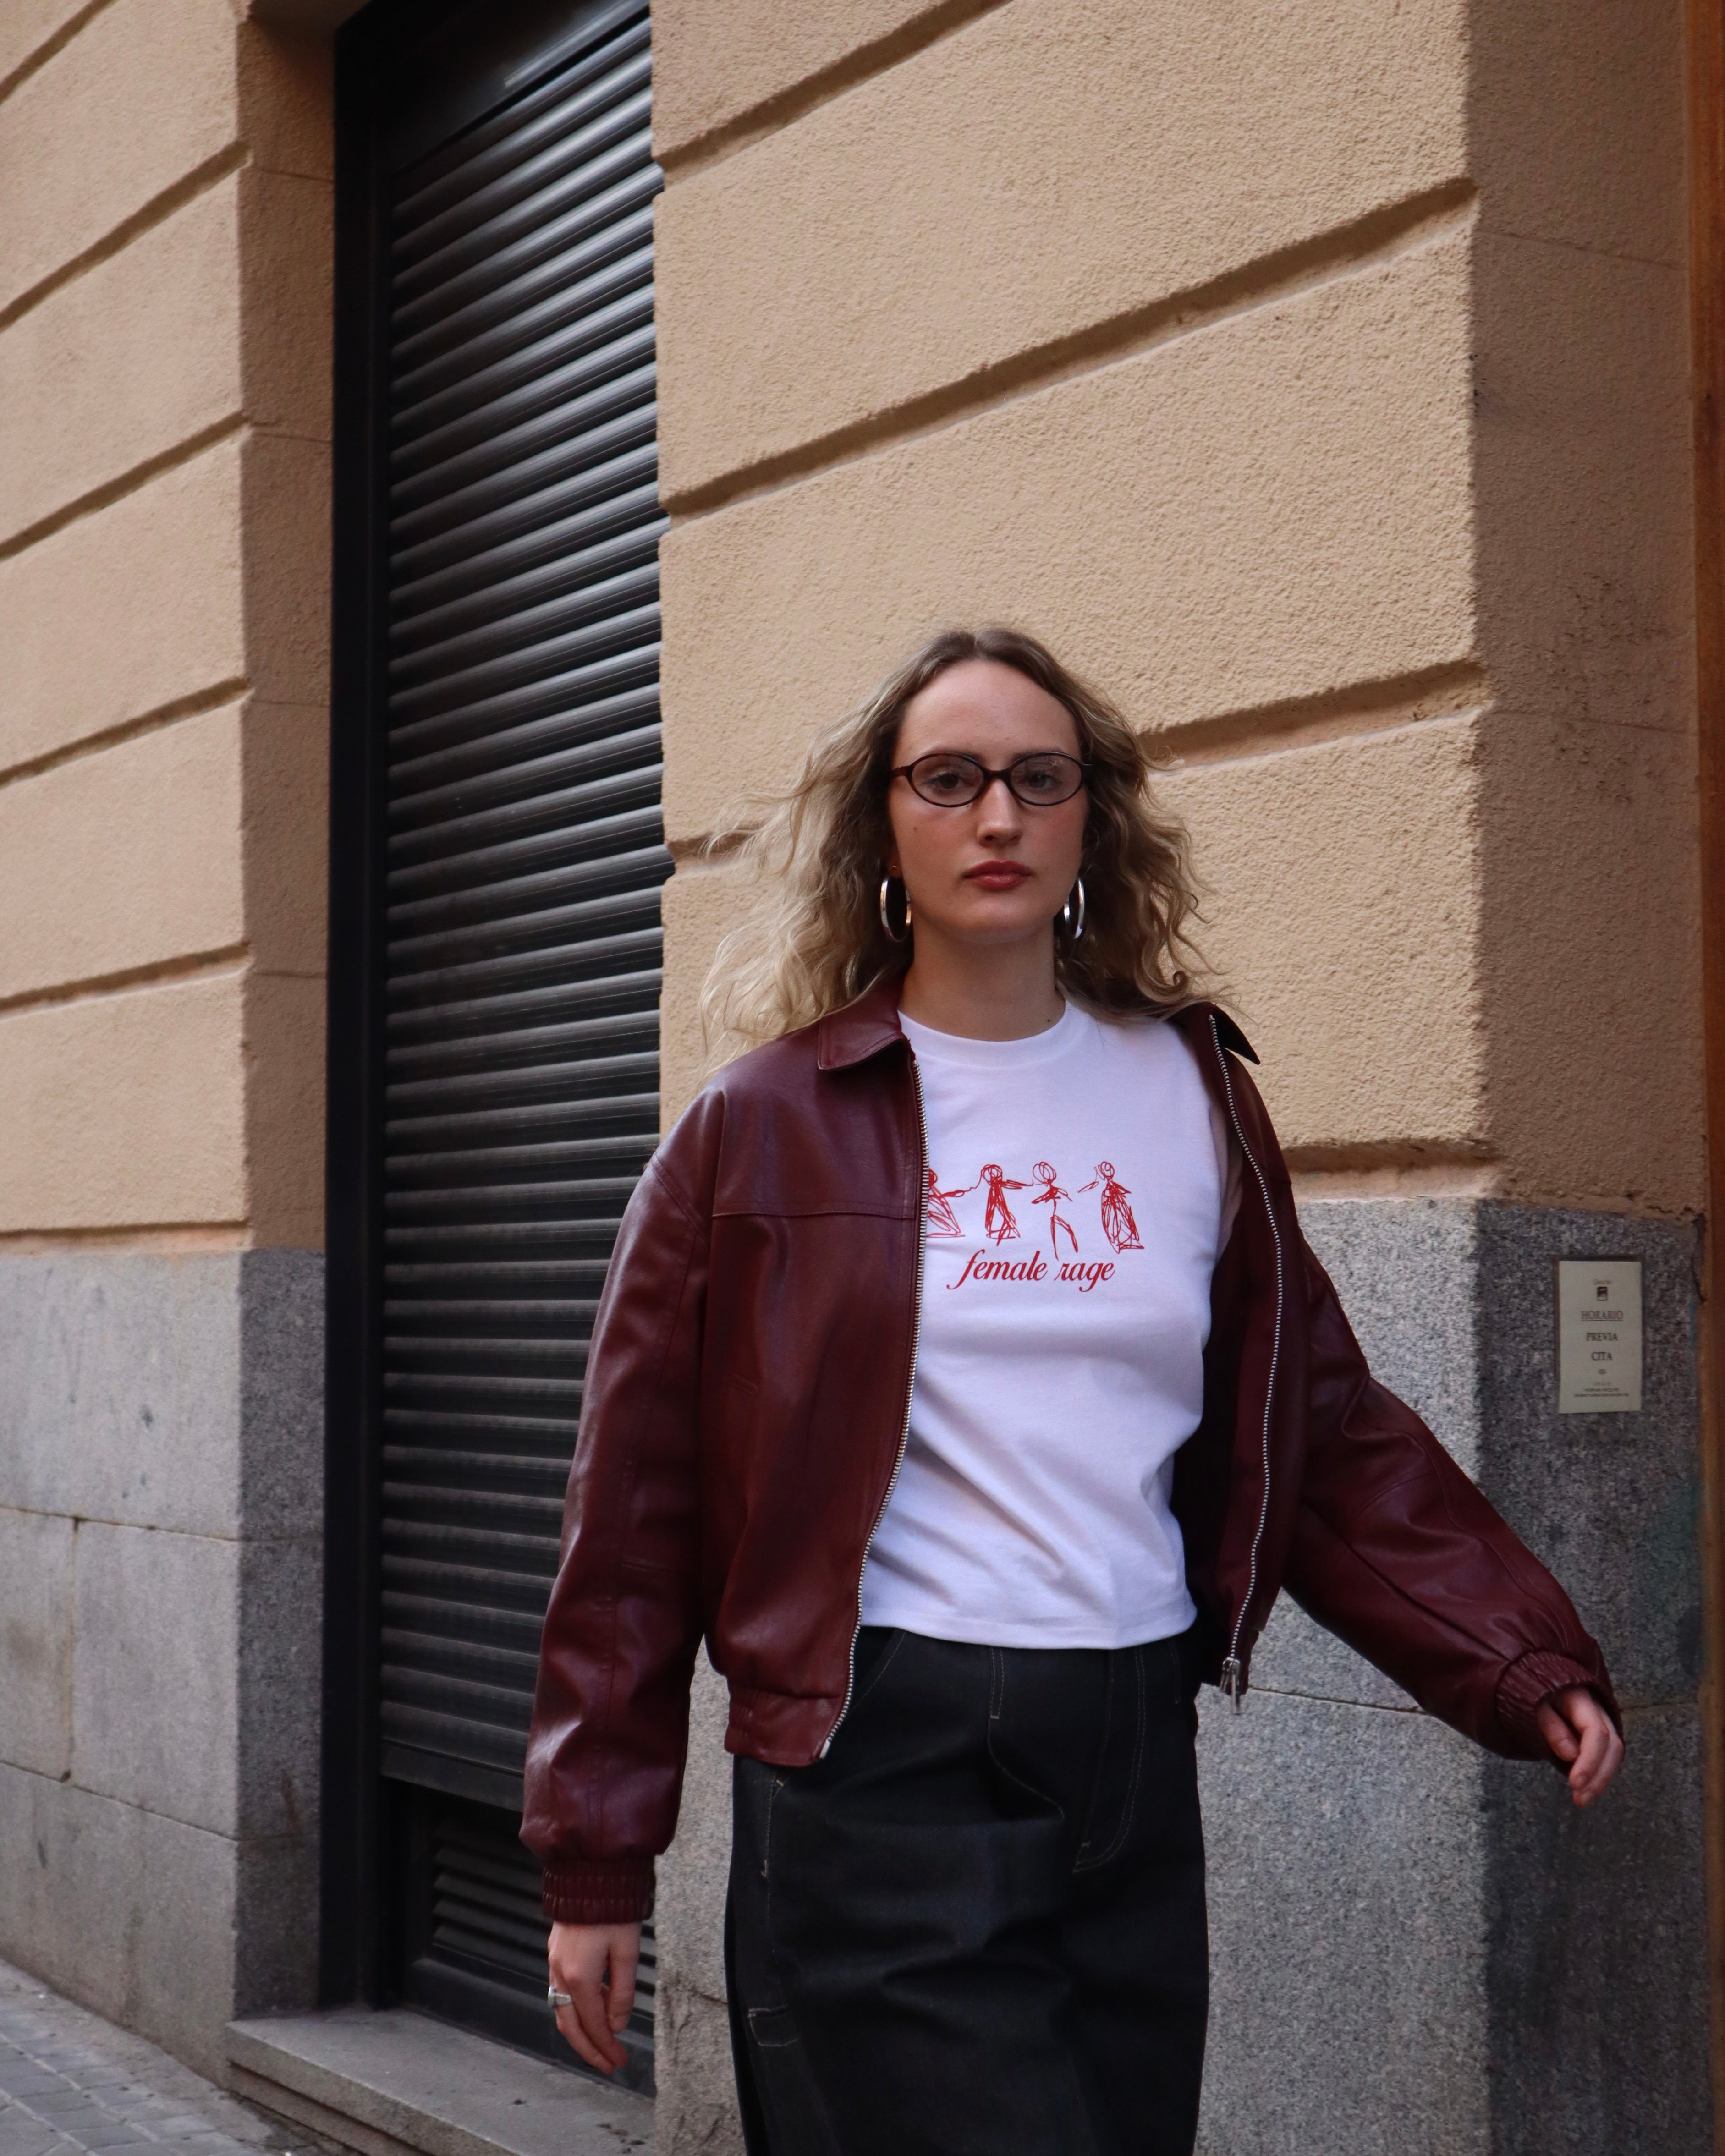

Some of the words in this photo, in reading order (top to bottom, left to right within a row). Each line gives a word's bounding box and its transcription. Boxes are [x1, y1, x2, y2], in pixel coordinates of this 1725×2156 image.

[946, 1249, 1048, 1289] female
[1054, 1262, 1115, 1292] rage
[1581, 1311, 1624, 1320] HORARIO
[1586, 1332, 1618, 1341] PREVIA
[1591, 1352, 1613, 1361] CITA
